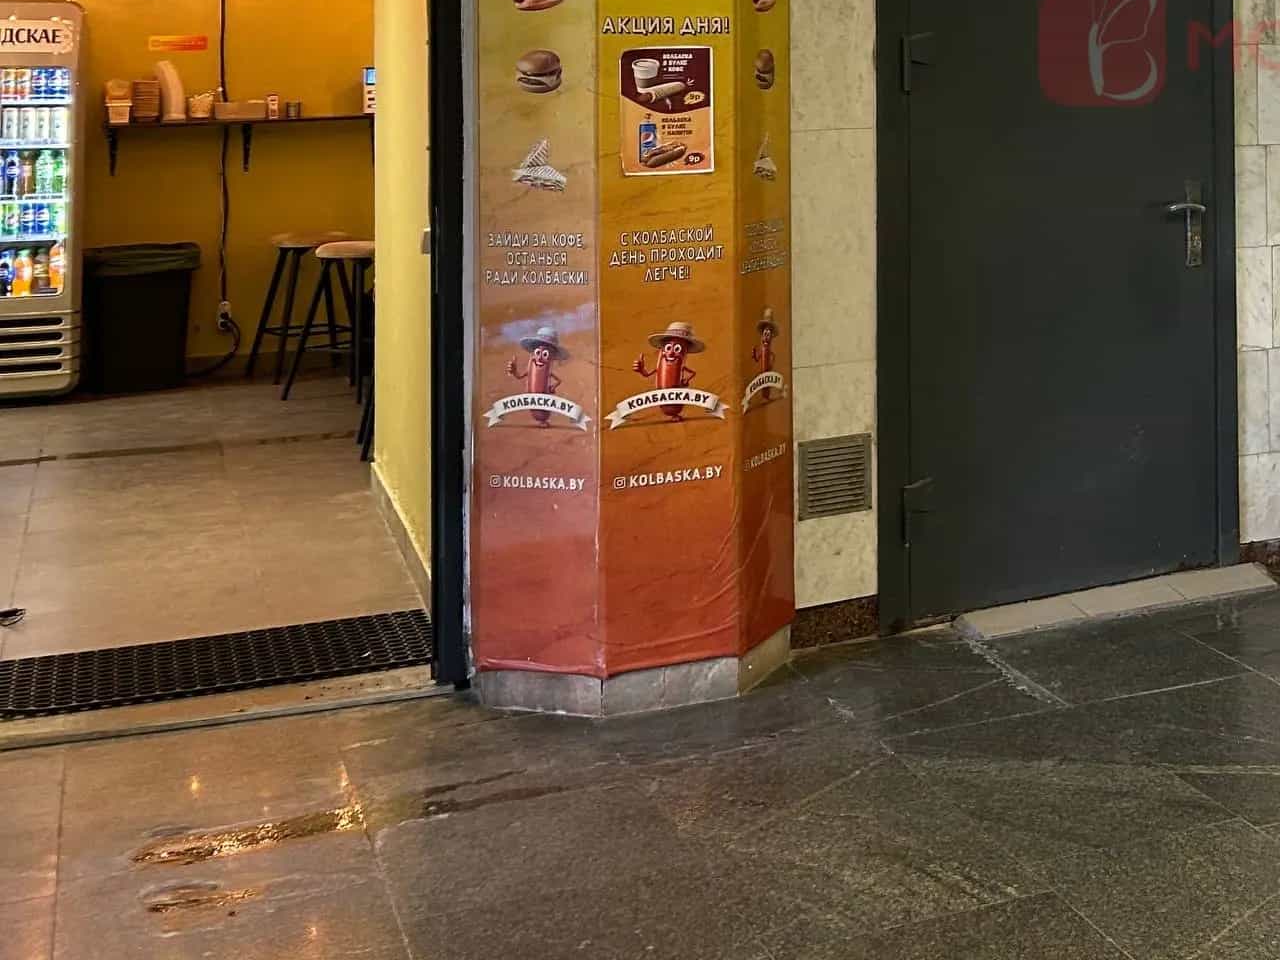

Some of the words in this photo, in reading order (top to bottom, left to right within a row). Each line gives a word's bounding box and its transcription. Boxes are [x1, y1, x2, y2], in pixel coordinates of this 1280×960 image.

[602, 16, 675, 36] АКЦИЯ
[679, 16, 730, 36] ДНЯ!
[0, 27, 63, 45] ДСКАЕ
[532, 232, 548, 247] ЗА
[620, 232, 628, 246] С
[632, 224, 714, 246] КОЛБАСКОЙ
[506, 251, 568, 266] ОСТАНЬСЯ
[609, 250, 647, 267] ДЕНЬ
[651, 245, 724, 262] ПРОХОДИТ
[486, 270, 518, 285] РАДИ
[644, 265, 691, 282] ЛЕГЧЕ!
[502, 397, 574, 413] КОЛБАСКА.BY
[628, 391, 710, 410] КОЛБАСКА.BY
[503, 475, 585, 491] KOLBASKA.BY
[630, 465, 723, 488] KOLBASKA.BY
